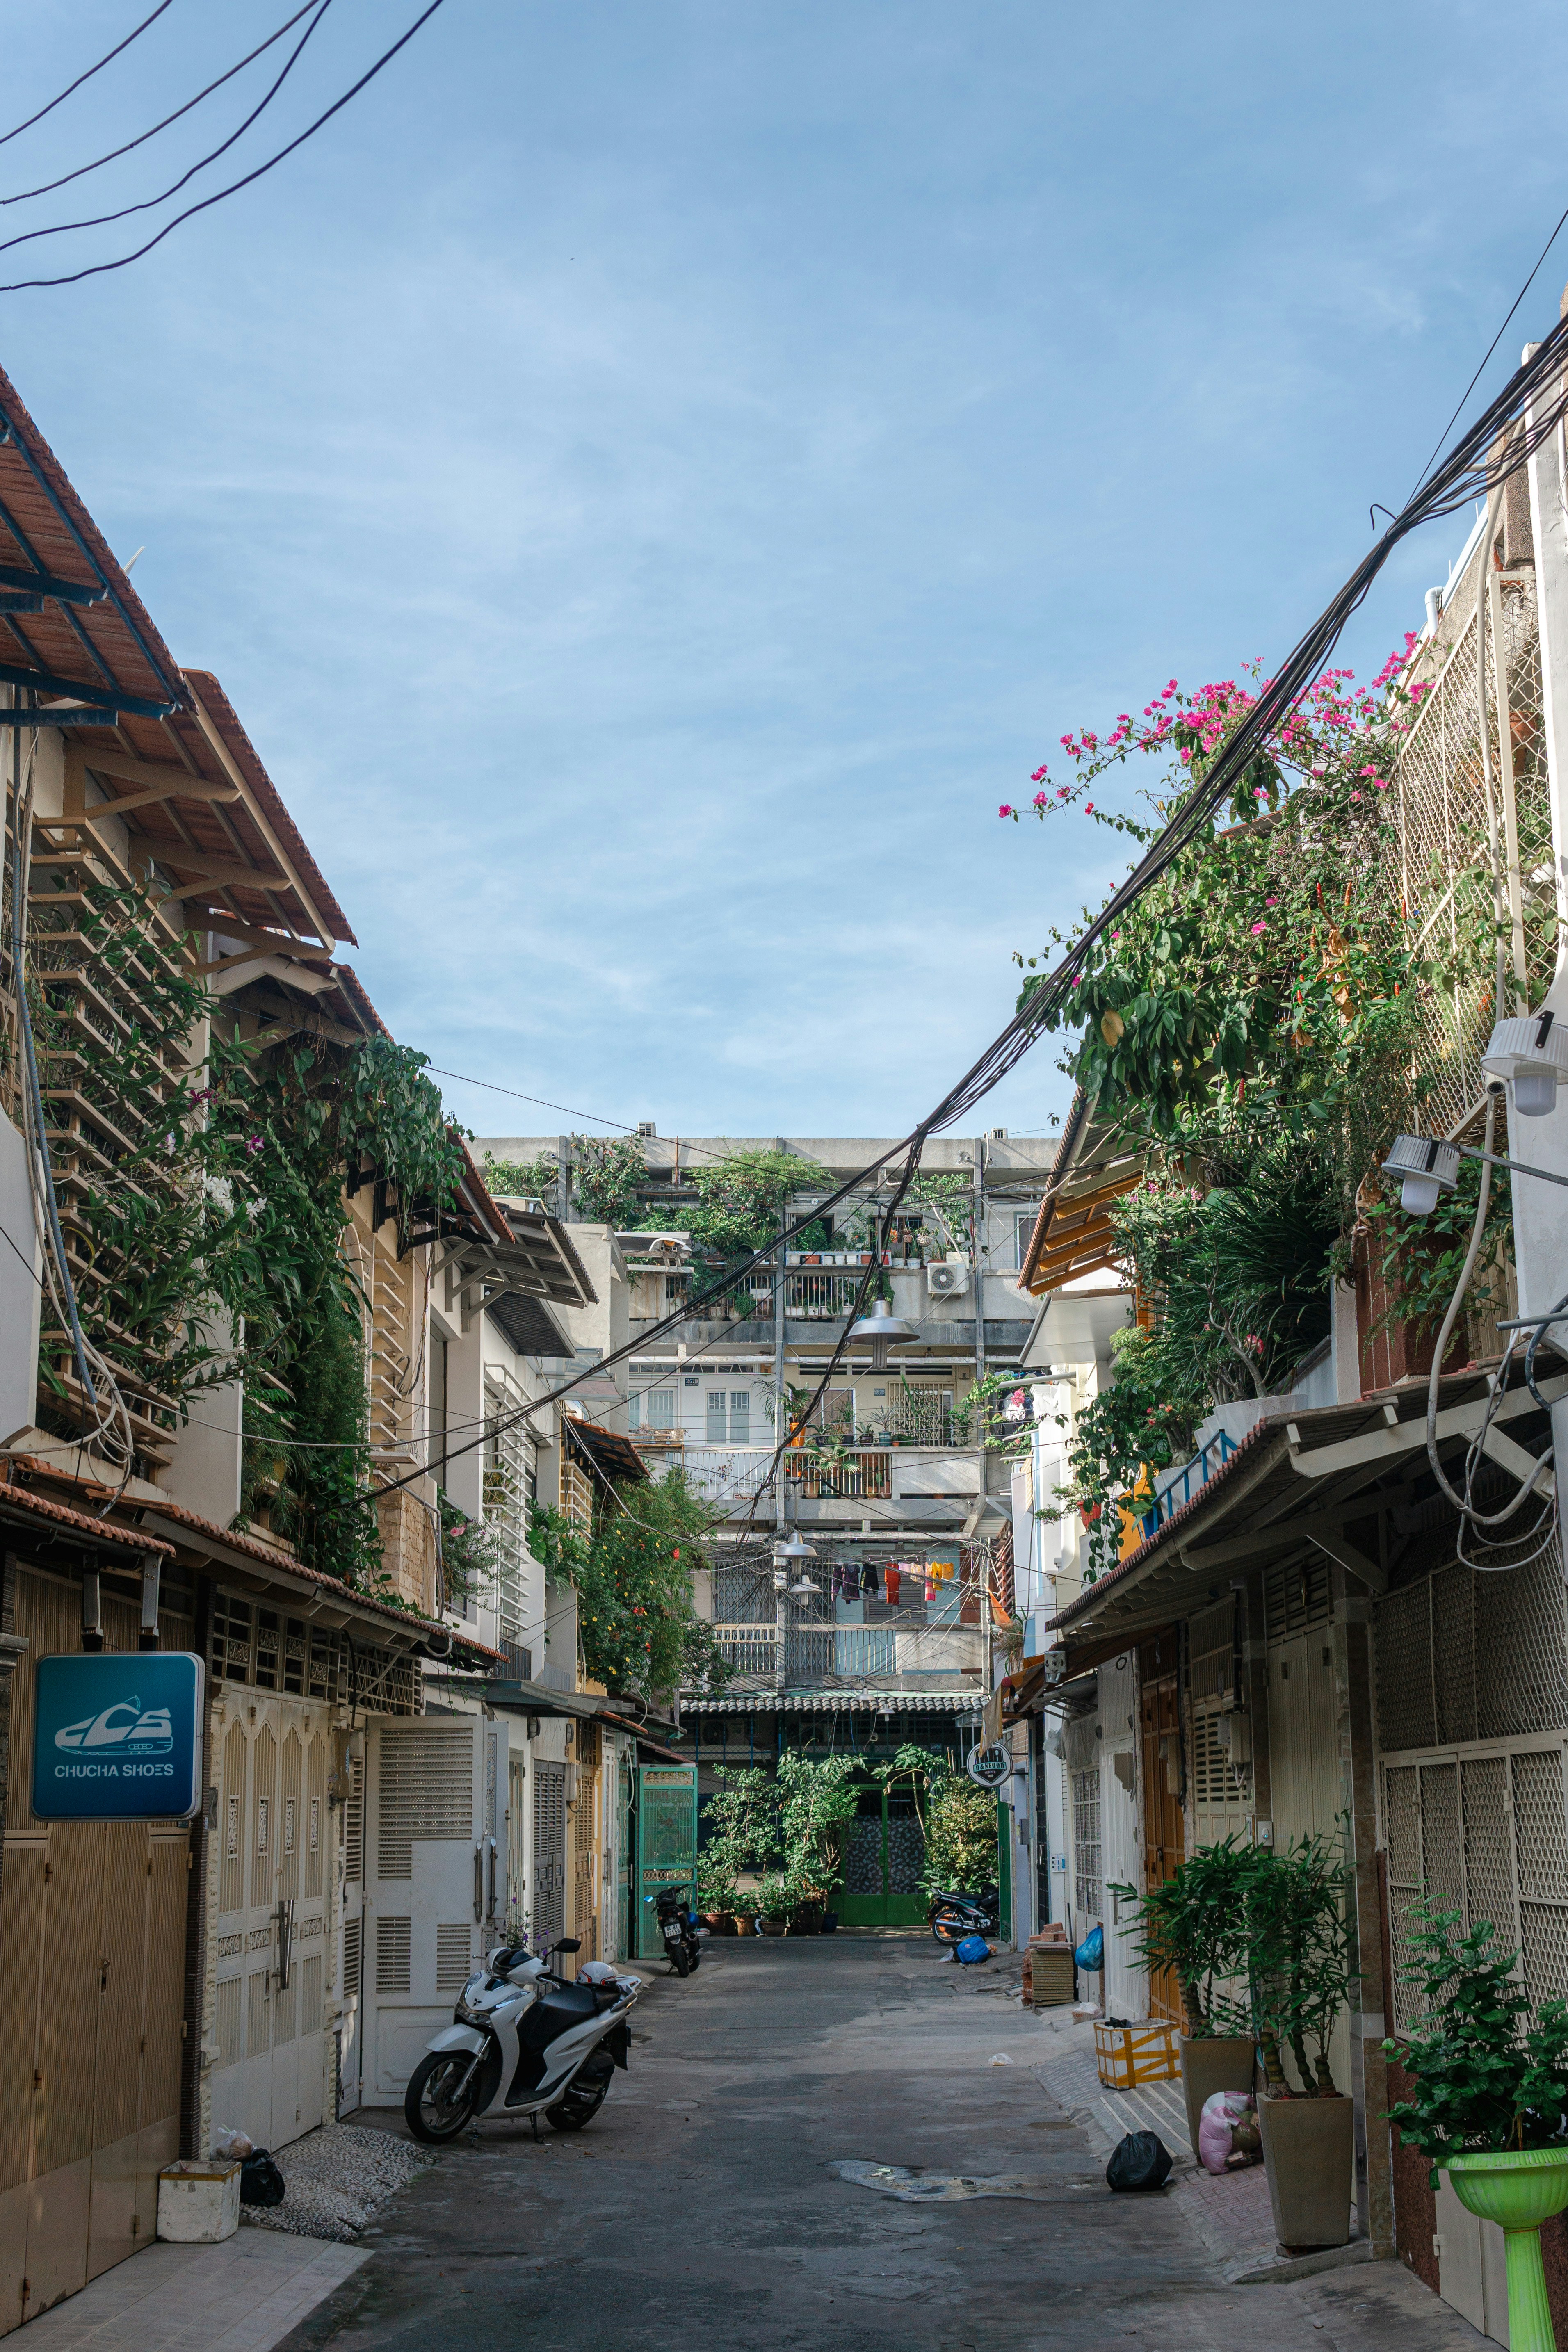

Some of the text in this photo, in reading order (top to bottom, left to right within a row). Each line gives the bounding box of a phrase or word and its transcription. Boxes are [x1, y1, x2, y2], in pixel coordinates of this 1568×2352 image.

[55, 1764, 174, 1777] CHUCHA SHOES
[976, 1763, 1004, 1771] D&NFOOD
